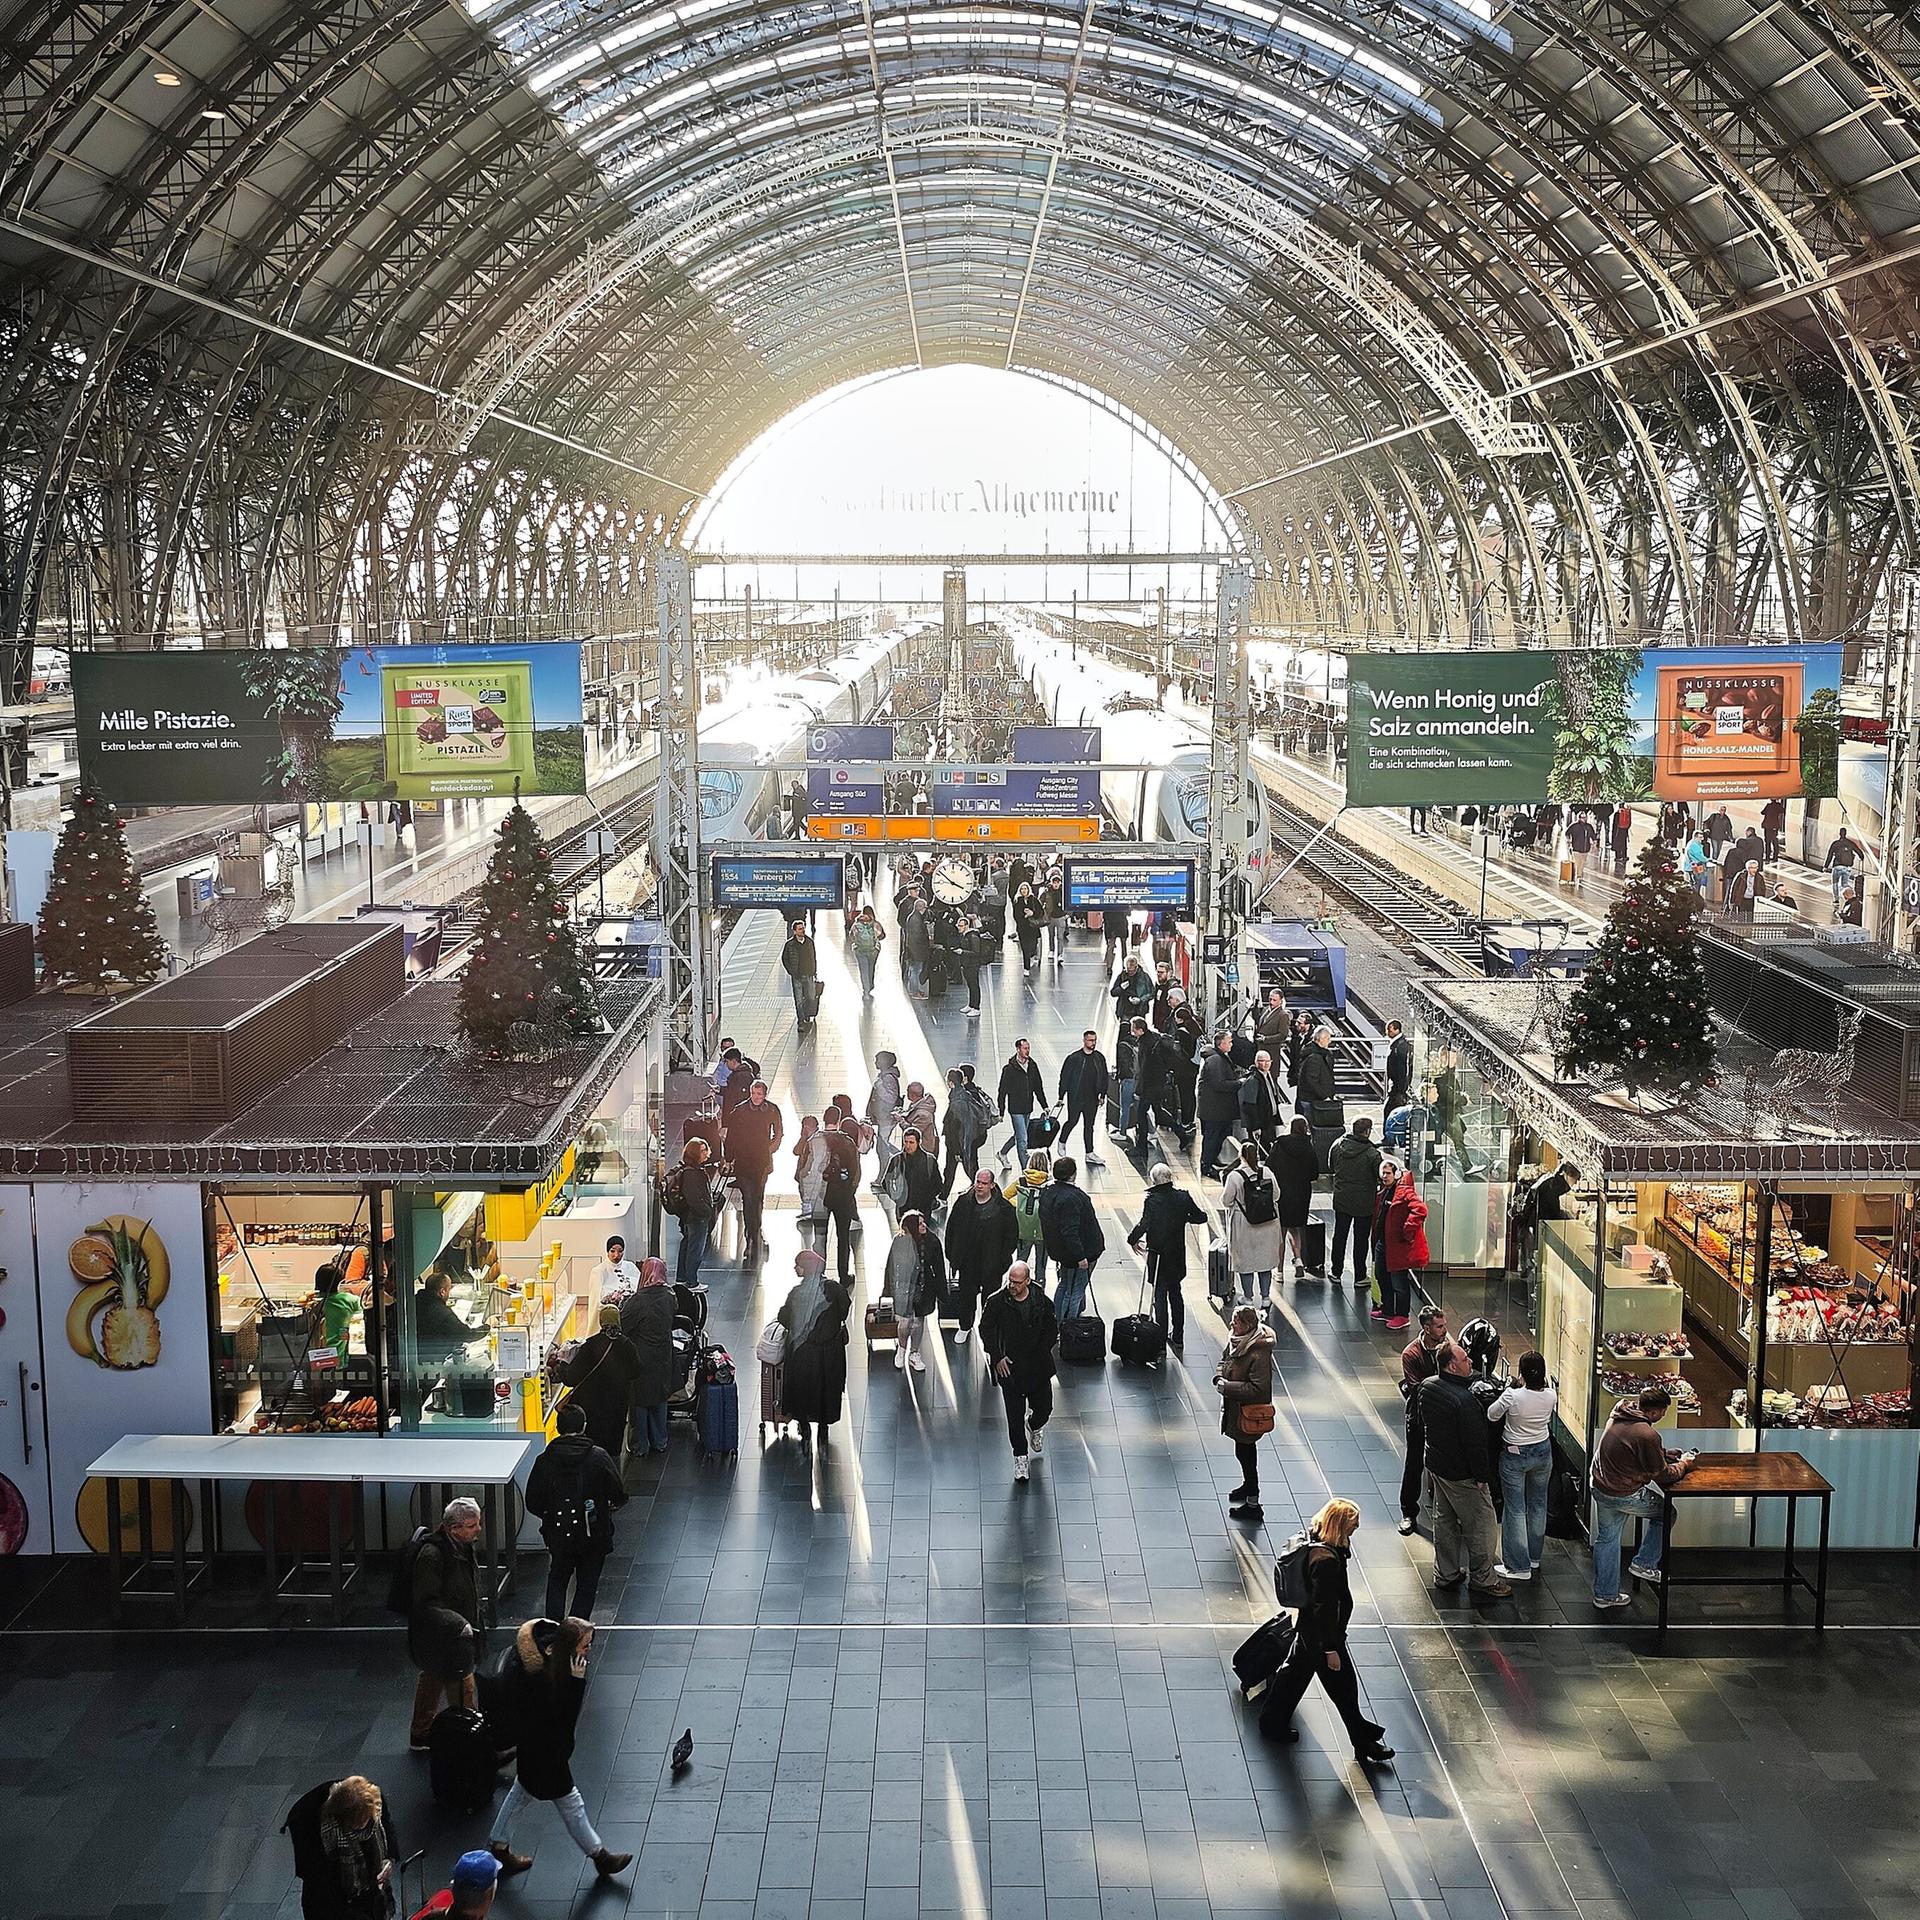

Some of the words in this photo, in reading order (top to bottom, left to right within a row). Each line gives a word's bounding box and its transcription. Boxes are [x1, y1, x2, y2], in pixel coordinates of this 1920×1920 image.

[968, 479, 1120, 518] Allgemeine
[415, 679, 499, 688] NUSSKLASSE
[1685, 679, 1776, 689] NUSSKLASSE
[1370, 689, 1429, 710] Wenn
[1435, 689, 1496, 714] Honig
[1502, 690, 1540, 707] und
[100, 709, 149, 730] Mille
[153, 710, 236, 729] Pistazie.
[1369, 716, 1411, 736] Salz
[1415, 714, 1535, 736] anmandeln.
[101, 741, 125, 751] Extra
[128, 740, 156, 750] lecker
[158, 740, 173, 750] mit
[175, 740, 198, 749] extra
[201, 739, 217, 749] viel
[220, 739, 242, 748] drin.
[812, 728, 827, 752] 6
[1081, 730, 1097, 753] 7
[437, 745, 484, 755] PISTAZIE
[1369, 747, 1388, 757] Eine
[1391, 746, 1451, 757] Kombination,
[1682, 745, 1775, 755] HONIG-SALZ-MANDEL
[1369, 759, 1384, 769] die
[1386, 758, 1403, 769] sich
[1406, 758, 1454, 768] schmecken
[1458, 757, 1485, 768] lassen
[1488, 757, 1512, 767] kann.
[942, 772, 951, 783] U
[989, 772, 1000, 783] S
[829, 790, 854, 798] Ausgang
[753, 873, 783, 882] Nürnberg
[1908, 879, 1918, 906] 8
